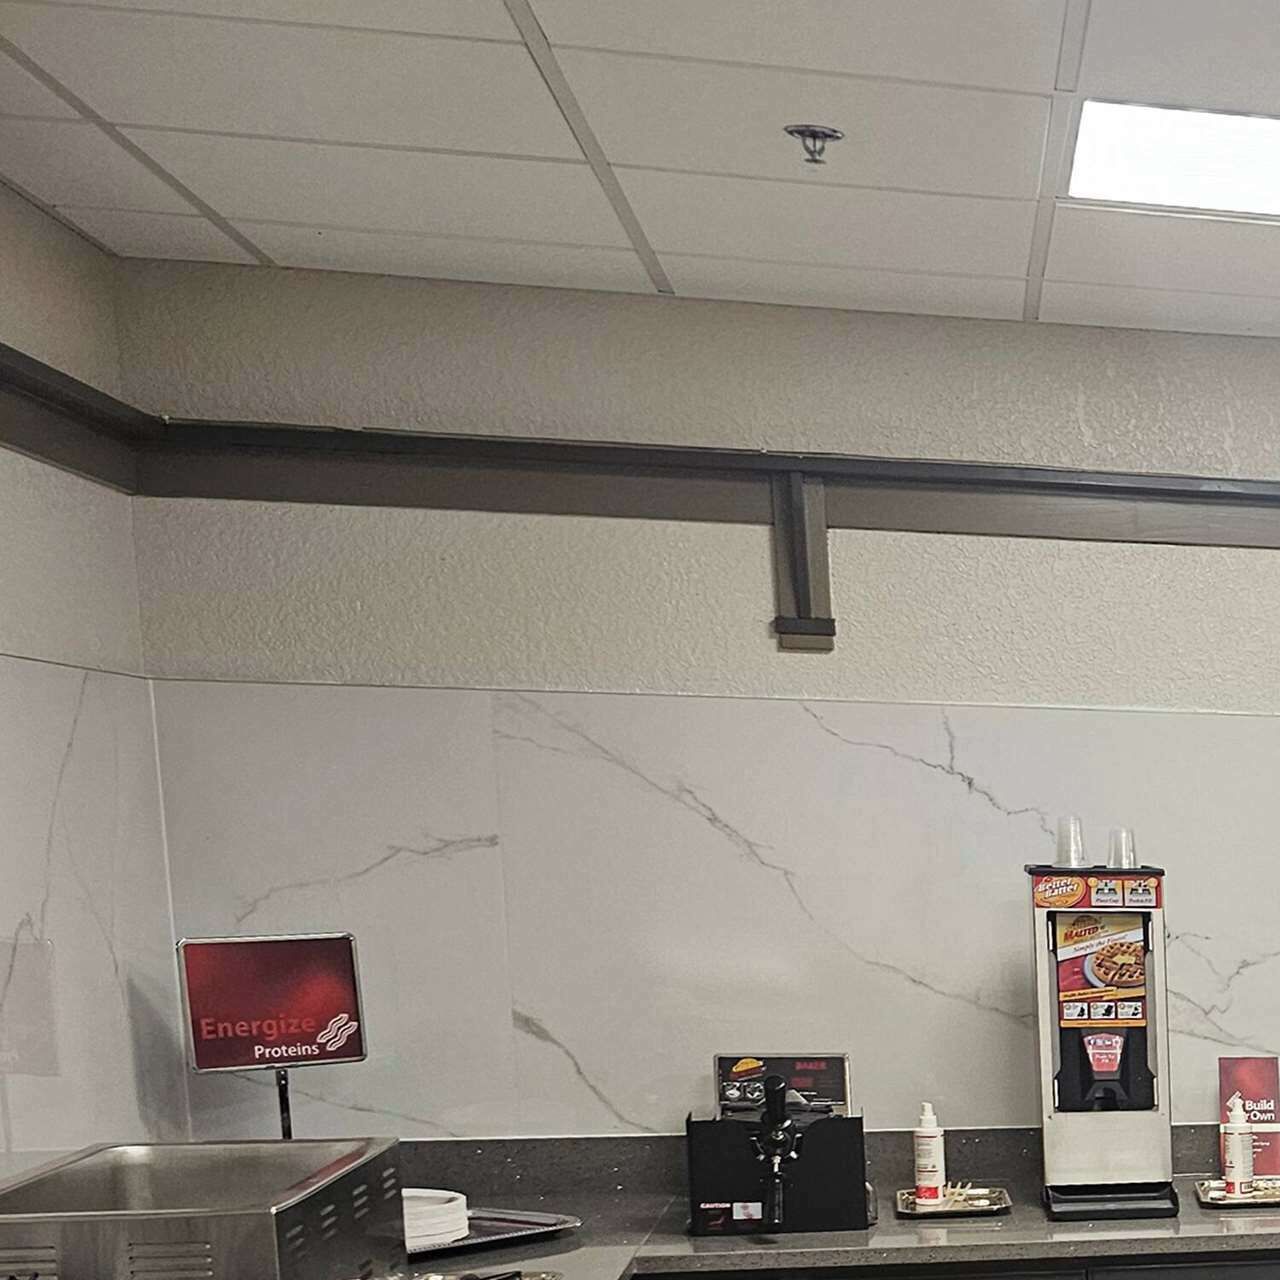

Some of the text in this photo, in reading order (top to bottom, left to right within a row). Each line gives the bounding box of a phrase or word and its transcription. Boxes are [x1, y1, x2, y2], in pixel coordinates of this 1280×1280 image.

[200, 1013, 316, 1041] Energize
[254, 1043, 320, 1059] Proteins
[1245, 1099, 1275, 1111] Build
[1250, 1110, 1275, 1121] Own
